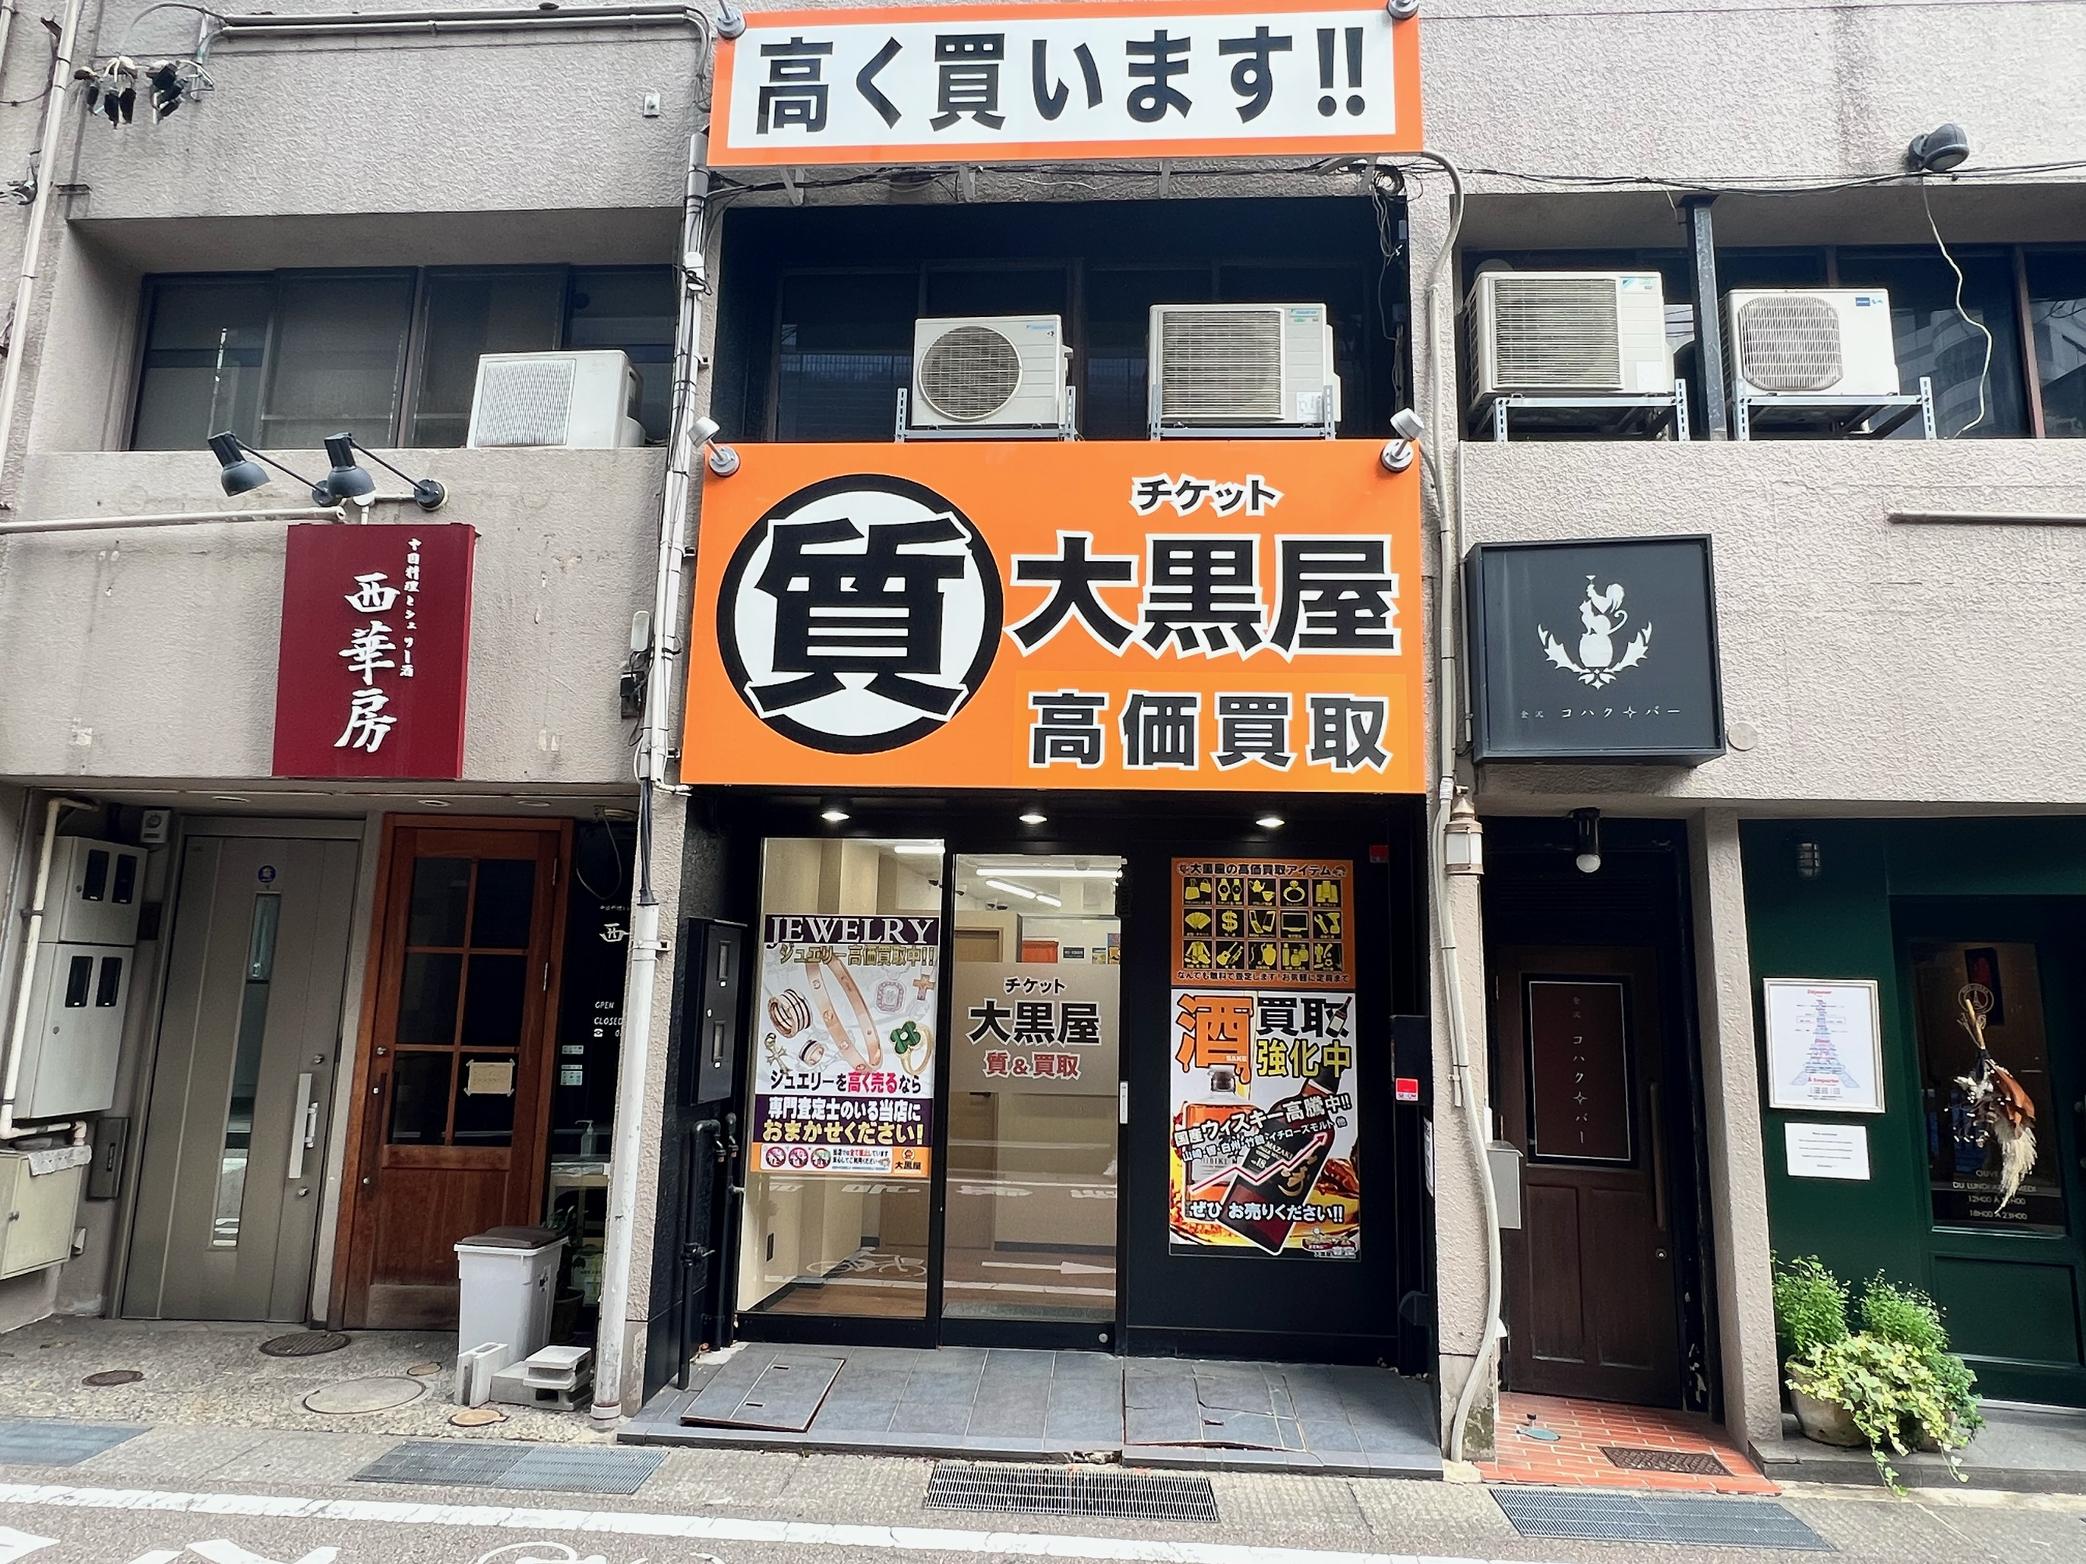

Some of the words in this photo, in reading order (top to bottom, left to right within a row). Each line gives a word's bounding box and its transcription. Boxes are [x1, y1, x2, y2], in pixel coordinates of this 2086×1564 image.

[757, 26, 1366, 134] 高く買います!!
[1132, 475, 1281, 516] チケット
[1013, 532, 1400, 659] 大黒屋
[743, 515, 972, 722] 質
[334, 571, 401, 754] 西華房
[1030, 690, 1391, 771] 高価買取
[767, 916, 934, 948] JEWELRY
[1005, 977, 1066, 995] チケット
[967, 998, 1102, 1046] 大黒屋
[1256, 997, 1350, 1038] 買取
[1175, 994, 1253, 1084] 酒
[1256, 1039, 1352, 1078] 強化中
[770, 1072, 922, 1094] ジュエリーを高く売るなら
[768, 1096, 922, 1122] 専門査定士のいる当店に
[762, 1119, 924, 1145] おまかせください!
[1190, 1200, 1223, 1218] ぜひ
